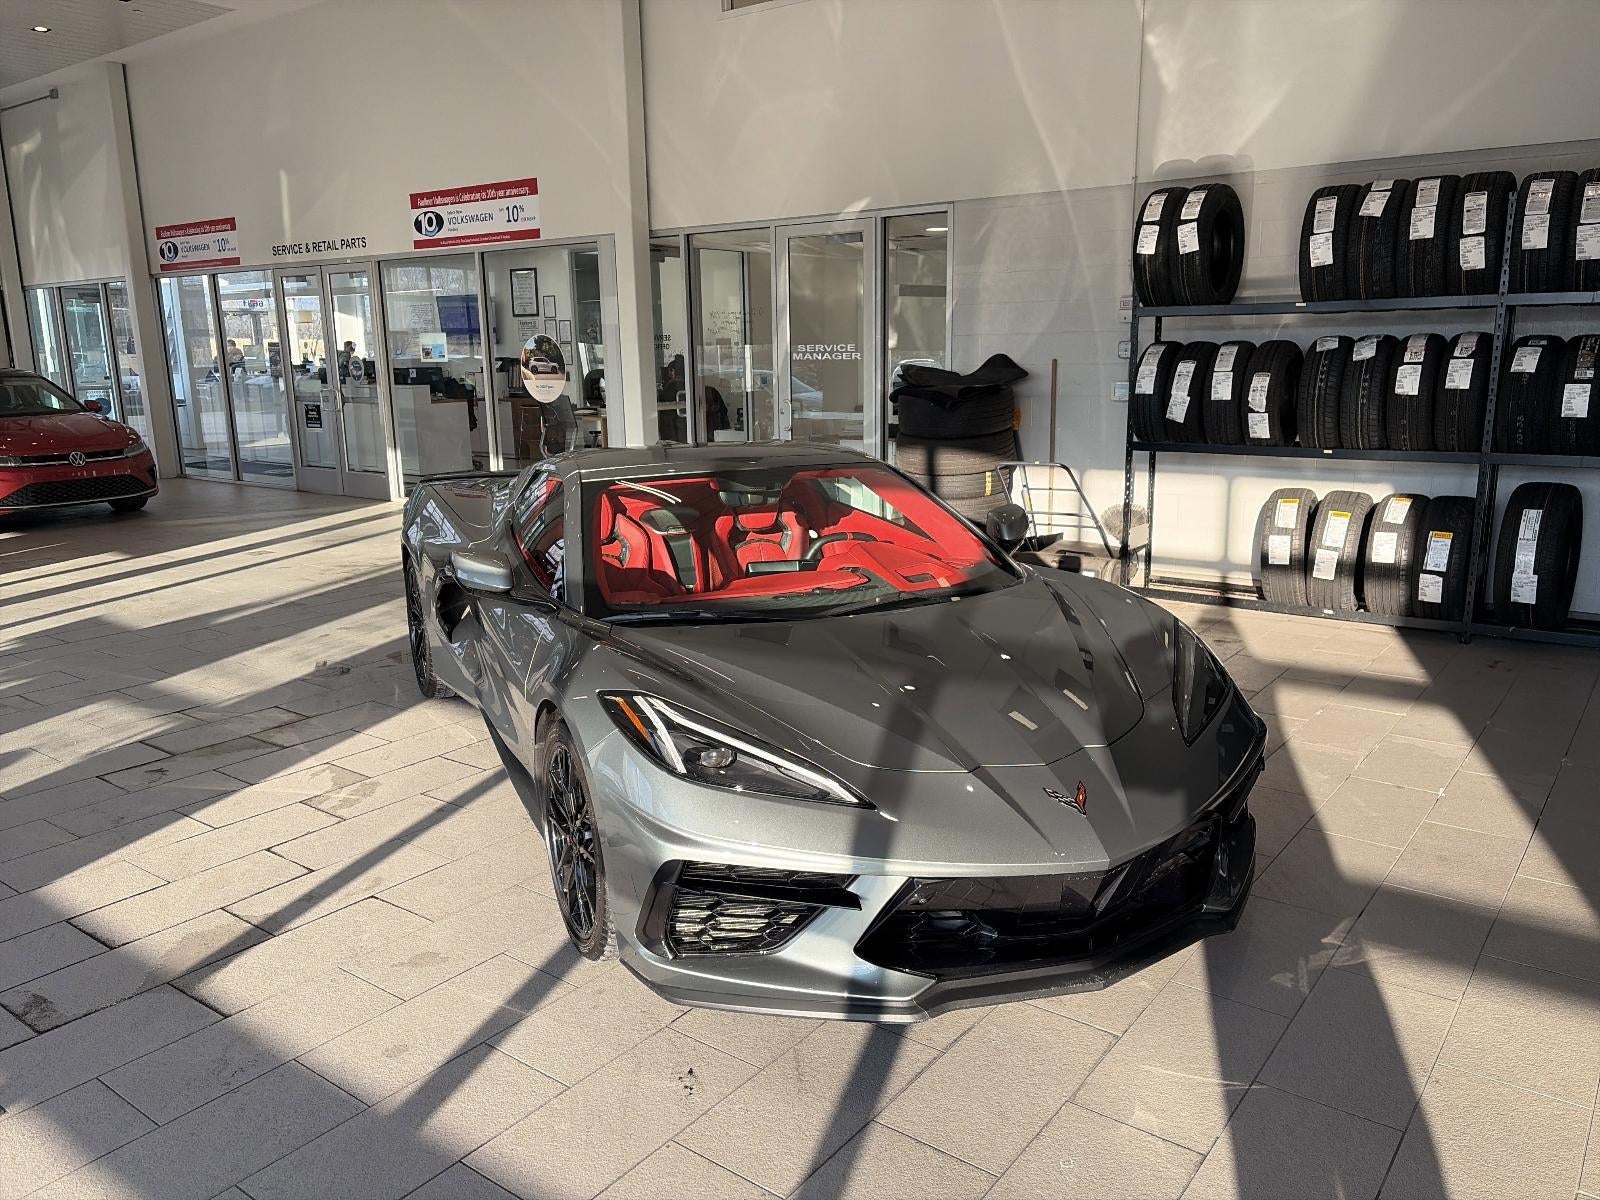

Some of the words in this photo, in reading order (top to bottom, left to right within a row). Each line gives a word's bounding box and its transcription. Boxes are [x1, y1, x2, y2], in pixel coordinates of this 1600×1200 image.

[447, 212, 494, 225] VOLKSWAGEN
[272, 243, 303, 256] SERVICE
[305, 242, 310, 253] &
[312, 240, 339, 253] RETAIL
[340, 237, 367, 249] PARTS
[797, 344, 856, 352] SERVICE
[792, 352, 862, 360] MANAGER
